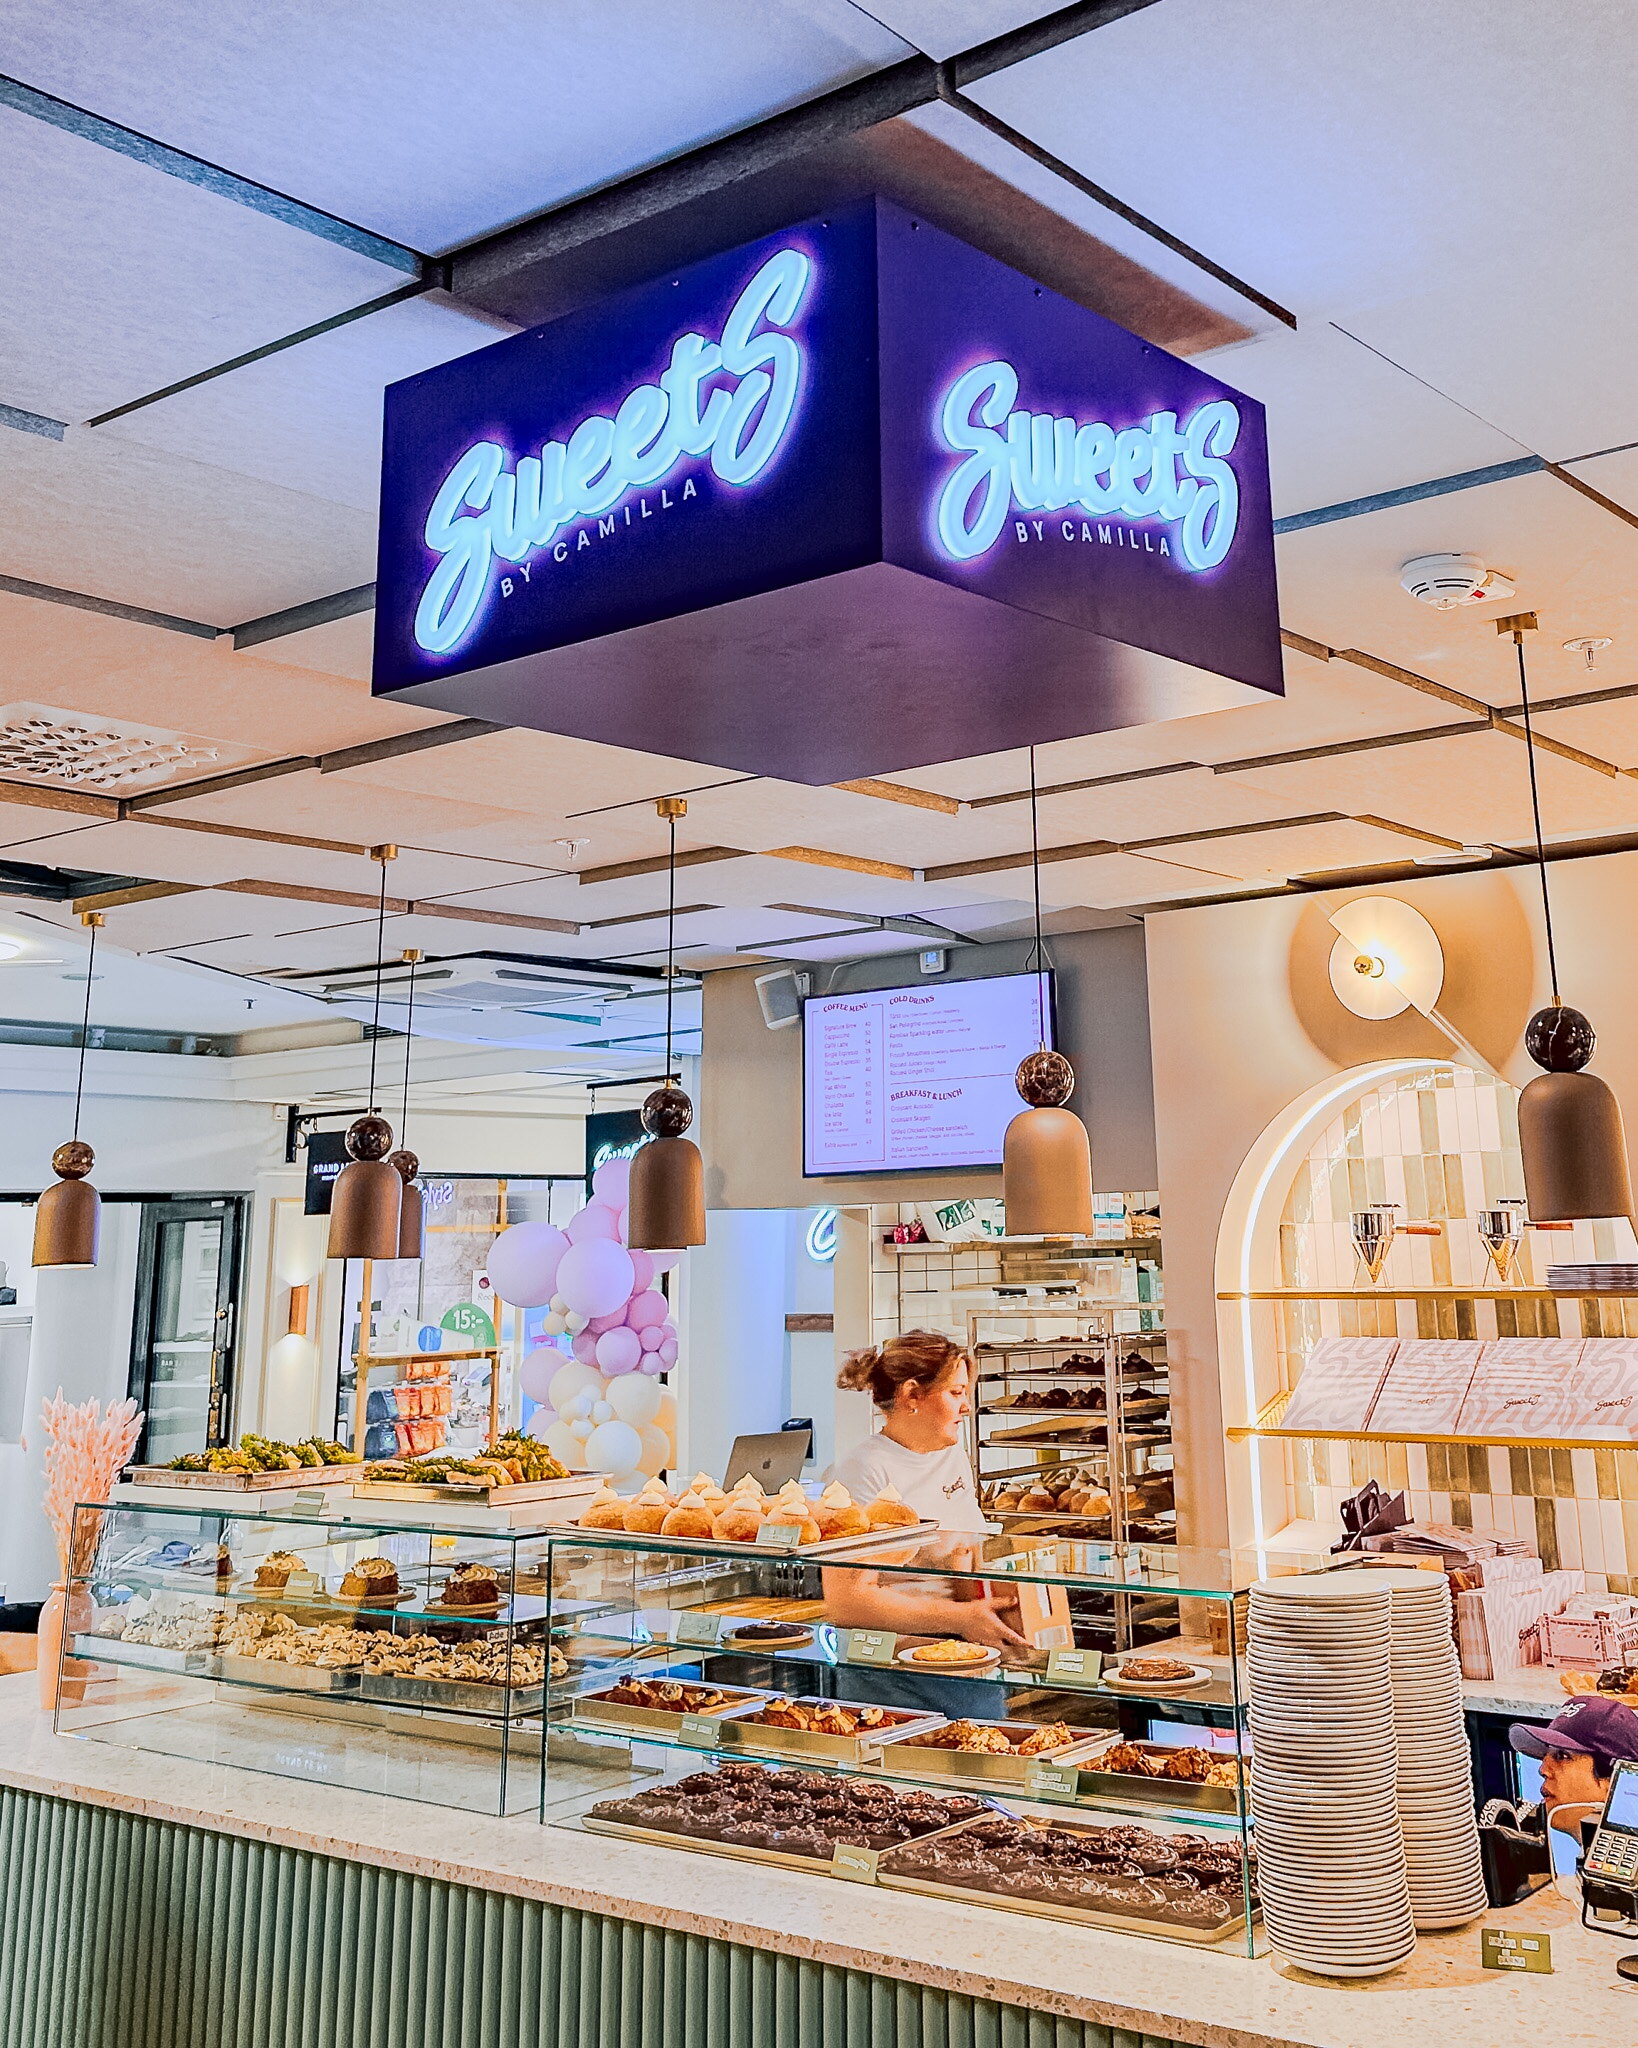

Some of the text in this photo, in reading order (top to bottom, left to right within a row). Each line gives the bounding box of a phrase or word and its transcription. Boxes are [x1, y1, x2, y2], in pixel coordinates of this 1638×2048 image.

[500, 478, 699, 599] BY CAMILLA
[1014, 521, 1172, 557] BY CAMILLA
[823, 1001, 869, 1013] COFFEE MENU
[889, 994, 935, 1005] COLD DRINKS
[890, 1087, 963, 1102] BREAKFAST & LUNCH
[313, 1163, 340, 1174] GRAND
[453, 1308, 484, 1330] 15:-
